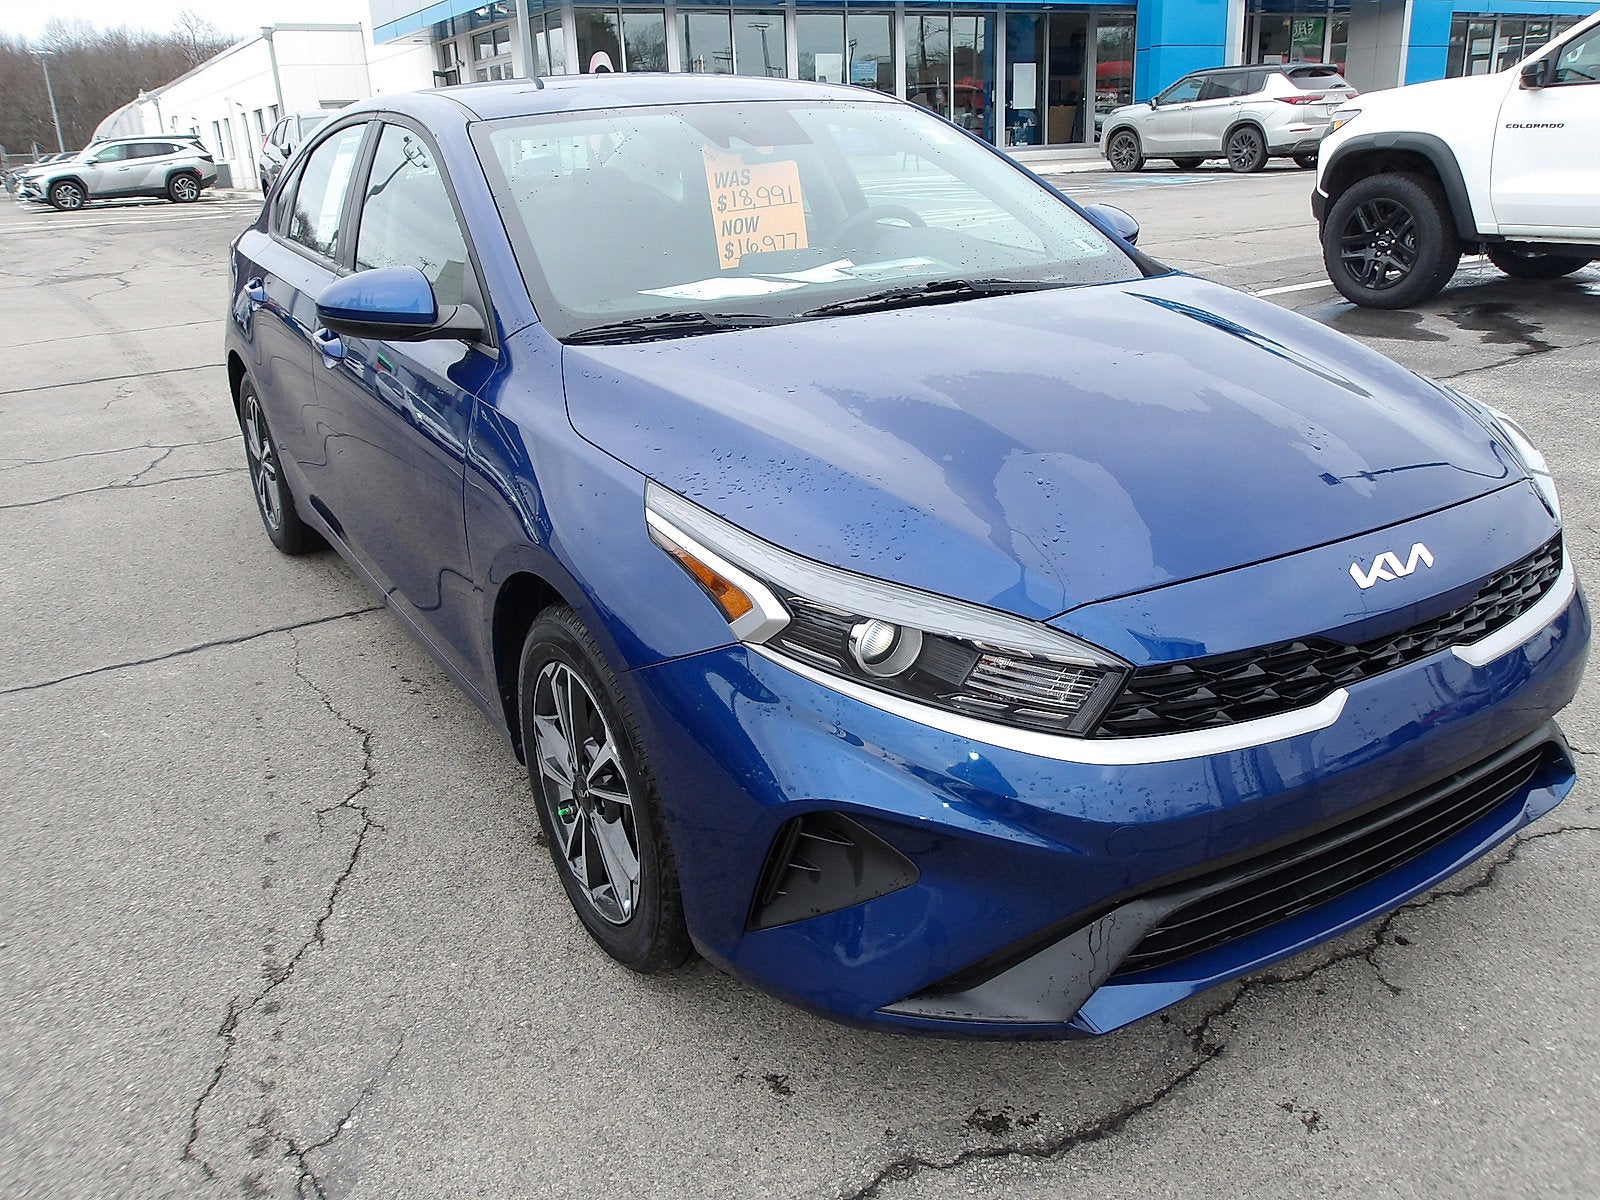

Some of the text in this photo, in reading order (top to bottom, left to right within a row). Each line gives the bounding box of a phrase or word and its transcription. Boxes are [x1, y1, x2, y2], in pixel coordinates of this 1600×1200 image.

[714, 168, 751, 189] WAS
[717, 185, 793, 213] $18,991
[721, 216, 760, 237] NOW
[1348, 542, 1434, 590] KIA
